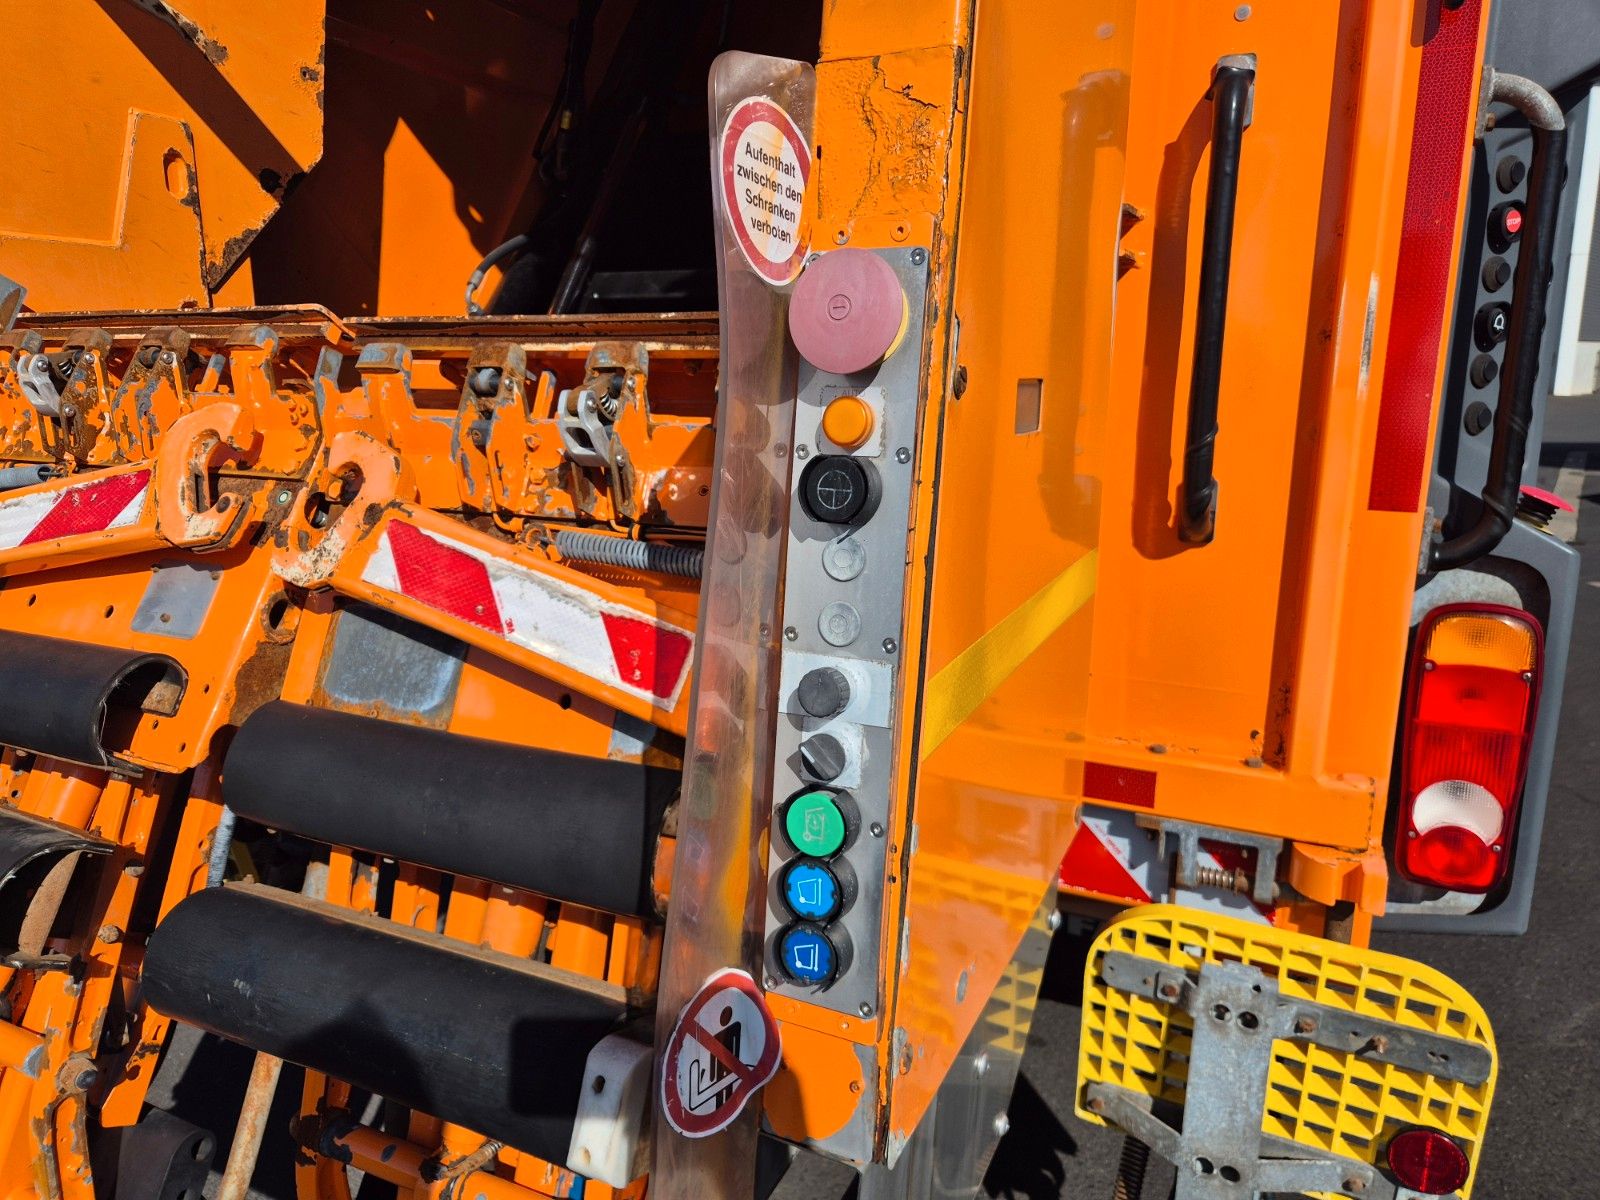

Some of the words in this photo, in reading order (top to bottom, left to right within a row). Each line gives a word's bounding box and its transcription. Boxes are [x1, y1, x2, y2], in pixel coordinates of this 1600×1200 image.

[745, 142, 795, 178] Aufenthalt
[737, 164, 782, 193] zwischen
[785, 185, 802, 203] den
[745, 188, 795, 223] Schranken
[1506, 217, 1521, 227] STOP
[751, 217, 791, 243] verboten
